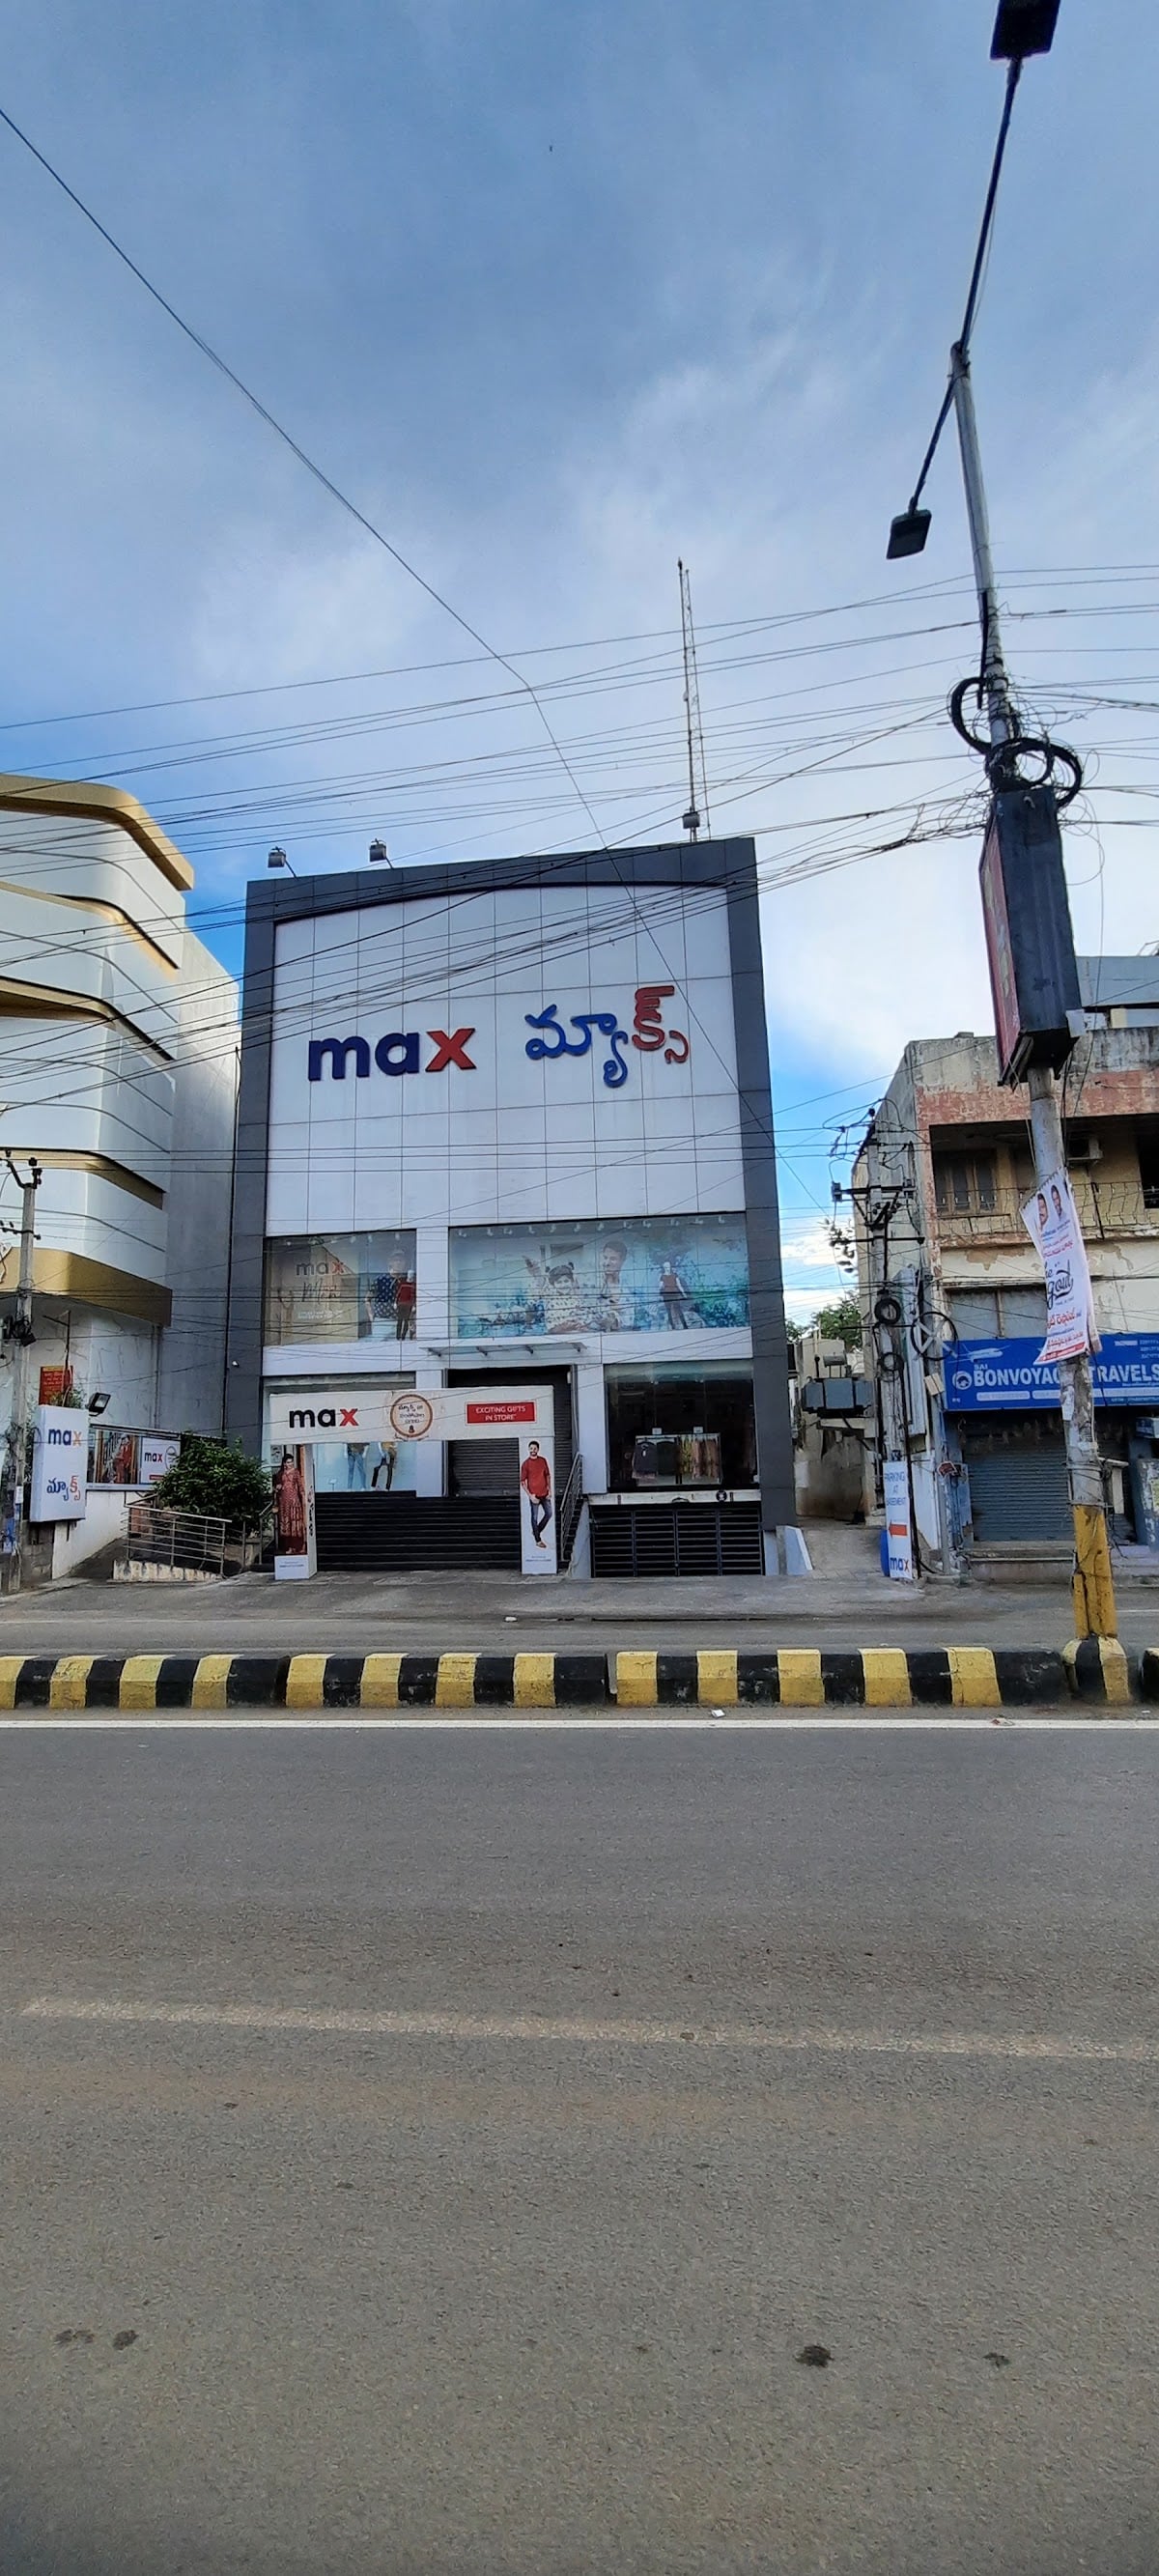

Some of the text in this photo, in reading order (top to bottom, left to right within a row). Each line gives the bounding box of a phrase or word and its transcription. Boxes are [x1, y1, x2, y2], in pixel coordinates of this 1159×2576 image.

[524, 985, 689, 1088] మ్యాక్స్
[308, 1028, 476, 1081] max
[296, 1261, 345, 1275] max
[974, 1367, 1060, 1387] BONVOYA
[289, 1408, 359, 1428] max
[48, 1429, 82, 1446] max
[144, 1452, 163, 1462] max
[890, 1557, 909, 1571] max
